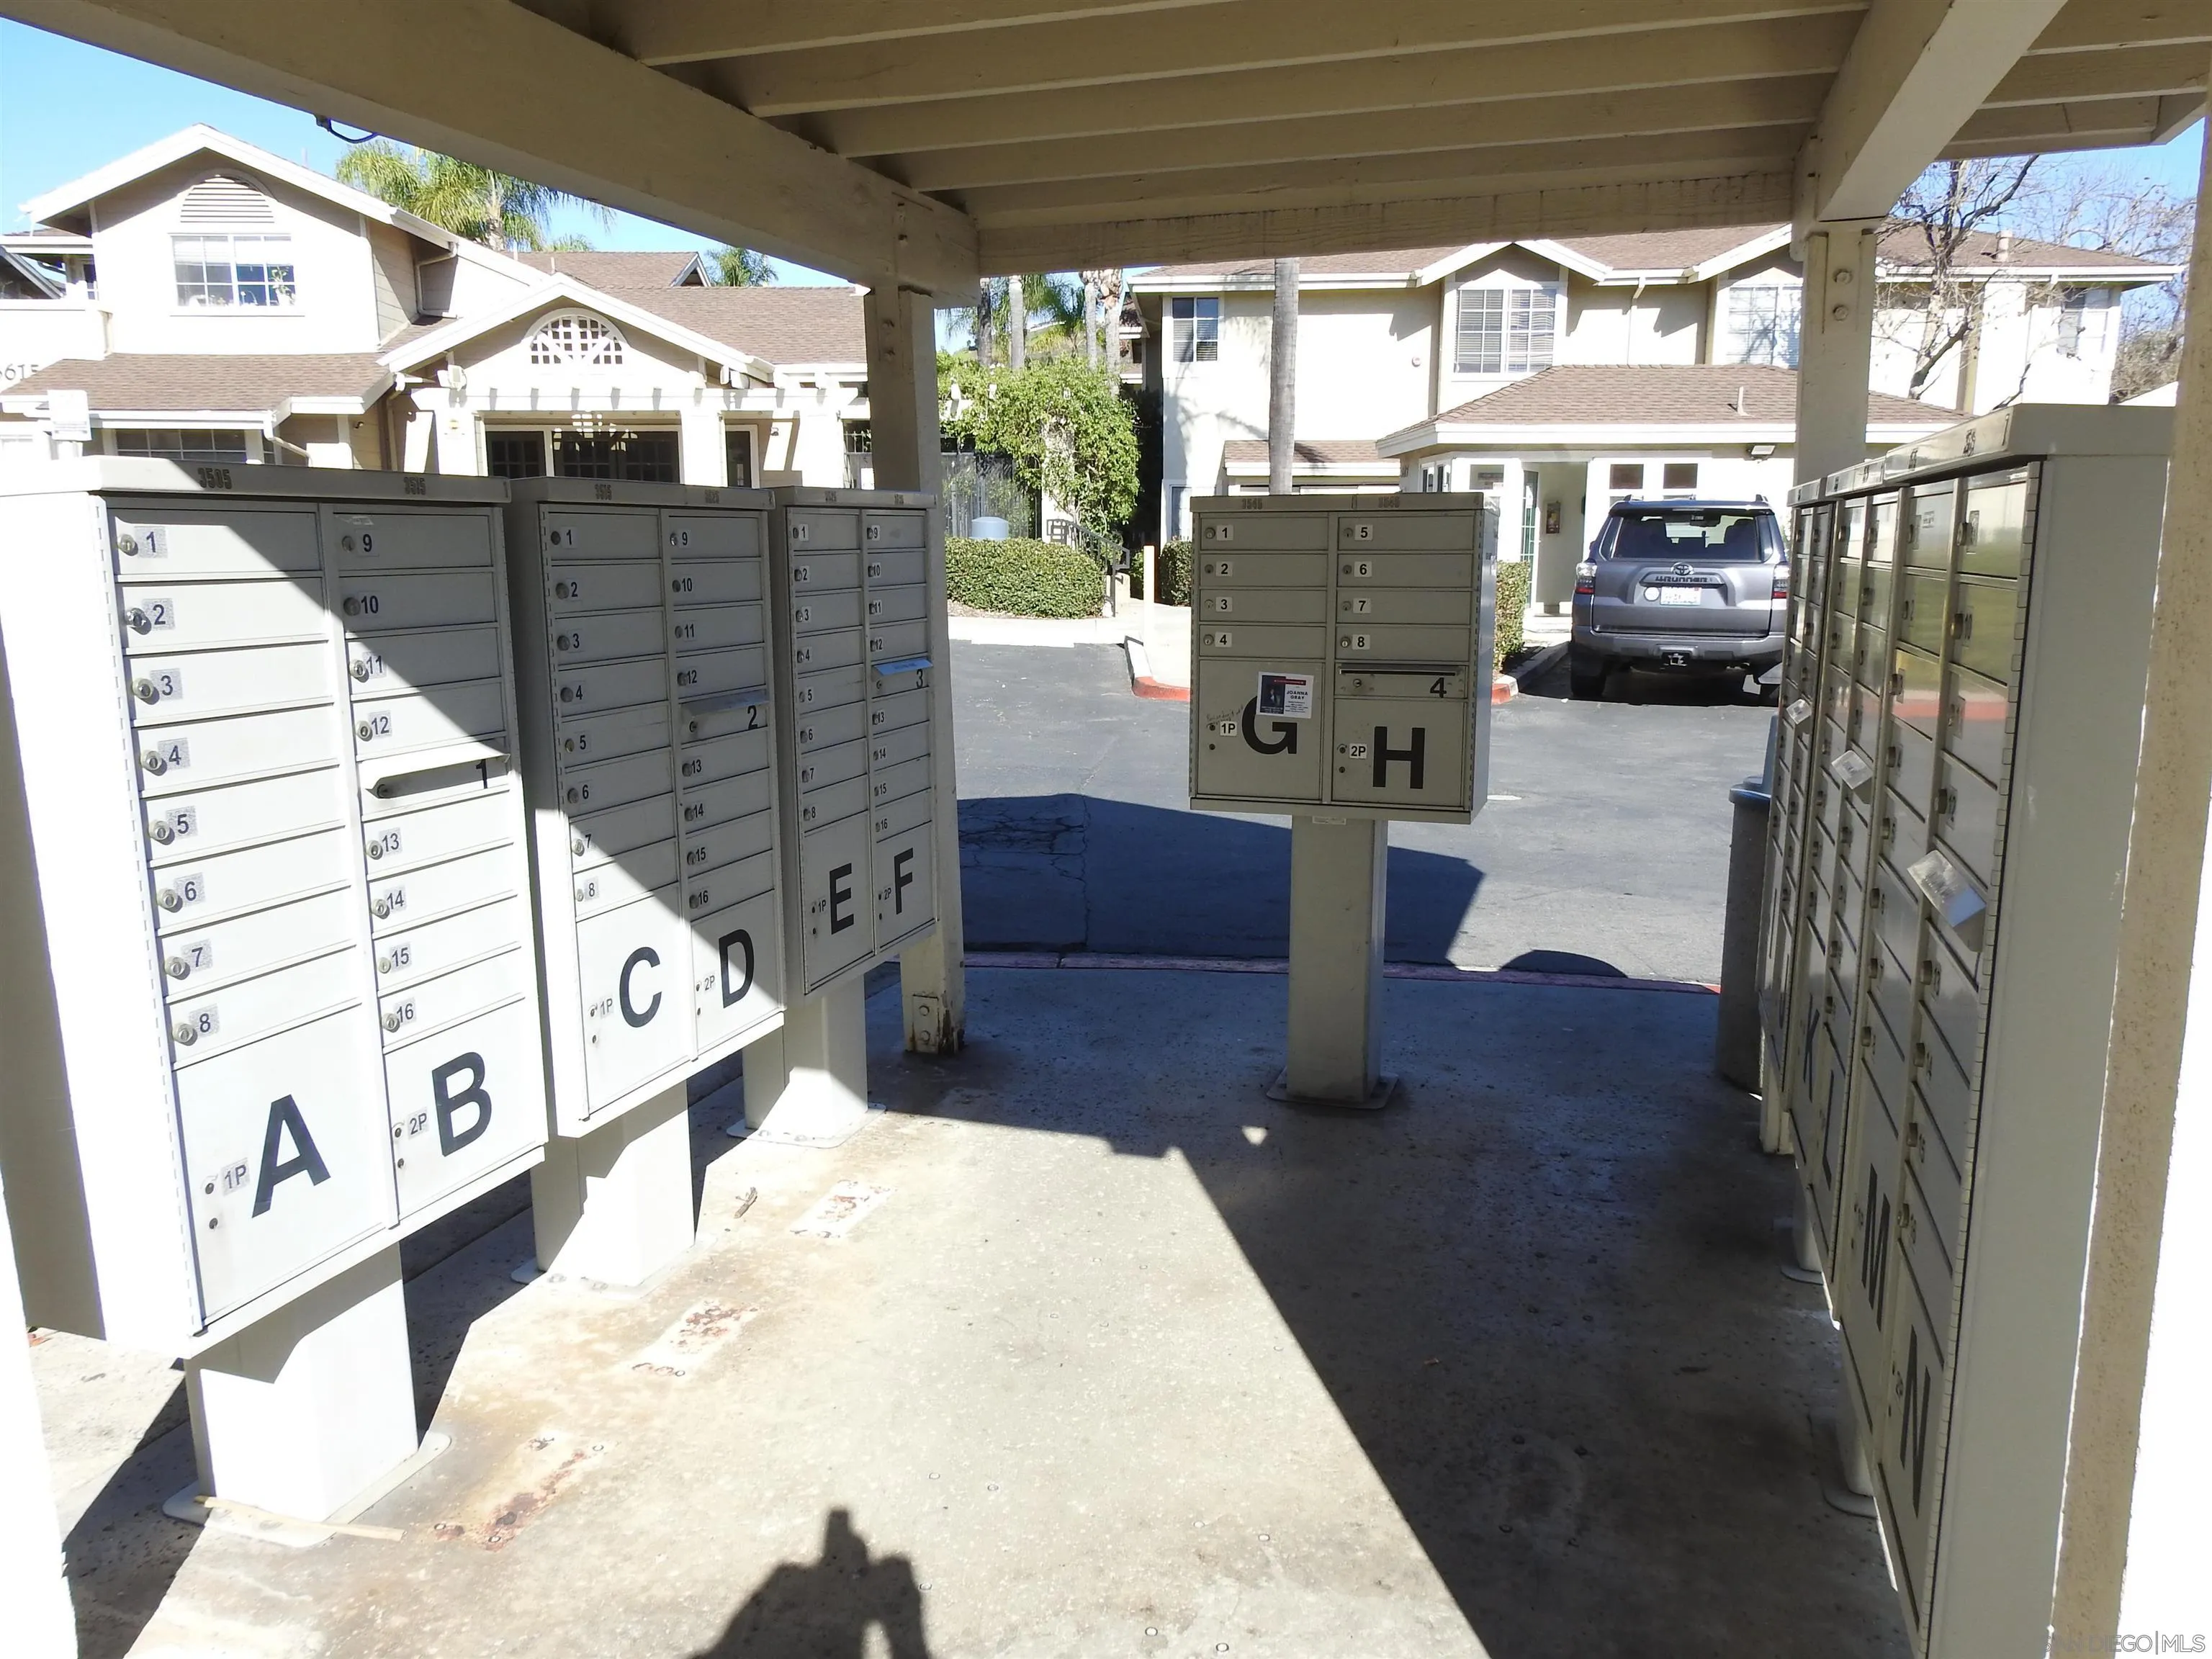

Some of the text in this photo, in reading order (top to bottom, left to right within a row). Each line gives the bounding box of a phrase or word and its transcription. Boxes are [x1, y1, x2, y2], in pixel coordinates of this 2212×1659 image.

[566, 529, 572, 545] 1
[682, 531, 688, 545] 9
[801, 526, 806, 539] 1
[873, 527, 878, 539] 9
[1222, 527, 1228, 539] 1
[1360, 527, 1368, 539] 5
[146, 531, 156, 552] 1
[362, 534, 372, 552] 9
[803, 568, 807, 581] 2
[873, 565, 880, 576] 10
[1220, 564, 1228, 575] 2
[1359, 564, 1367, 575] 6
[571, 582, 578, 597] 2
[681, 577, 692, 592] 10
[361, 595, 379, 613] 10
[874, 602, 881, 613] 11
[1220, 599, 1228, 610] 3
[1358, 601, 1367, 612] 7
[153, 604, 166, 625] 2
[804, 608, 809, 621] 3
[684, 624, 694, 638] 11
[572, 634, 580, 648] 3
[876, 639, 883, 650] 12
[1219, 634, 1228, 645] 4
[1357, 637, 1365, 647] 8
[805, 649, 810, 661] 4
[366, 655, 382, 674] 11
[686, 670, 697, 684] 12
[916, 668, 923, 688] 3
[161, 675, 173, 696] 3
[575, 685, 583, 700] 4
[1429, 677, 1447, 698] 4
[807, 689, 812, 702] 5
[747, 705, 757, 729] 2
[878, 711, 884, 723] 13
[1242, 694, 1298, 755] G
[371, 716, 389, 734] 12
[1221, 723, 1236, 734] 1P
[580, 735, 586, 750] 5
[809, 729, 813, 741] 6
[168, 745, 181, 765] 4
[879, 748, 886, 760] 14
[1351, 745, 1366, 757] 2P
[1372, 726, 1426, 789] H
[476, 758, 487, 788] 1
[692, 760, 702, 773] 13
[809, 768, 814, 781] 7
[582, 785, 589, 800] 6
[879, 783, 886, 796] 15
[693, 805, 703, 819] 14
[811, 806, 817, 819] 8
[176, 814, 189, 834] 5
[880, 818, 888, 831] 16
[382, 832, 400, 852] 13
[585, 834, 592, 849] 7
[696, 848, 706, 861] 15
[894, 848, 913, 914] F
[184, 881, 197, 901] 6
[588, 883, 595, 897] 8
[698, 890, 709, 904] 16
[884, 888, 891, 901] 2P
[387, 890, 405, 909] 14
[818, 899, 826, 914] 1P
[830, 863, 854, 935] E
[192, 947, 203, 967] 7
[392, 948, 409, 967] 15
[719, 928, 755, 1009] D
[619, 946, 662, 1028] C
[704, 976, 715, 991] 2P
[601, 998, 613, 1012] 1P
[397, 1004, 413, 1022] 16
[199, 1013, 211, 1033] 8
[1804, 992, 1820, 1103] K
[432, 1052, 492, 1157] B
[410, 1112, 427, 1135] 2P
[1822, 1069, 1835, 1191] L
[252, 1094, 331, 1218] A
[224, 1164, 247, 1190] 1P
[1900, 1324, 1930, 1519] N
